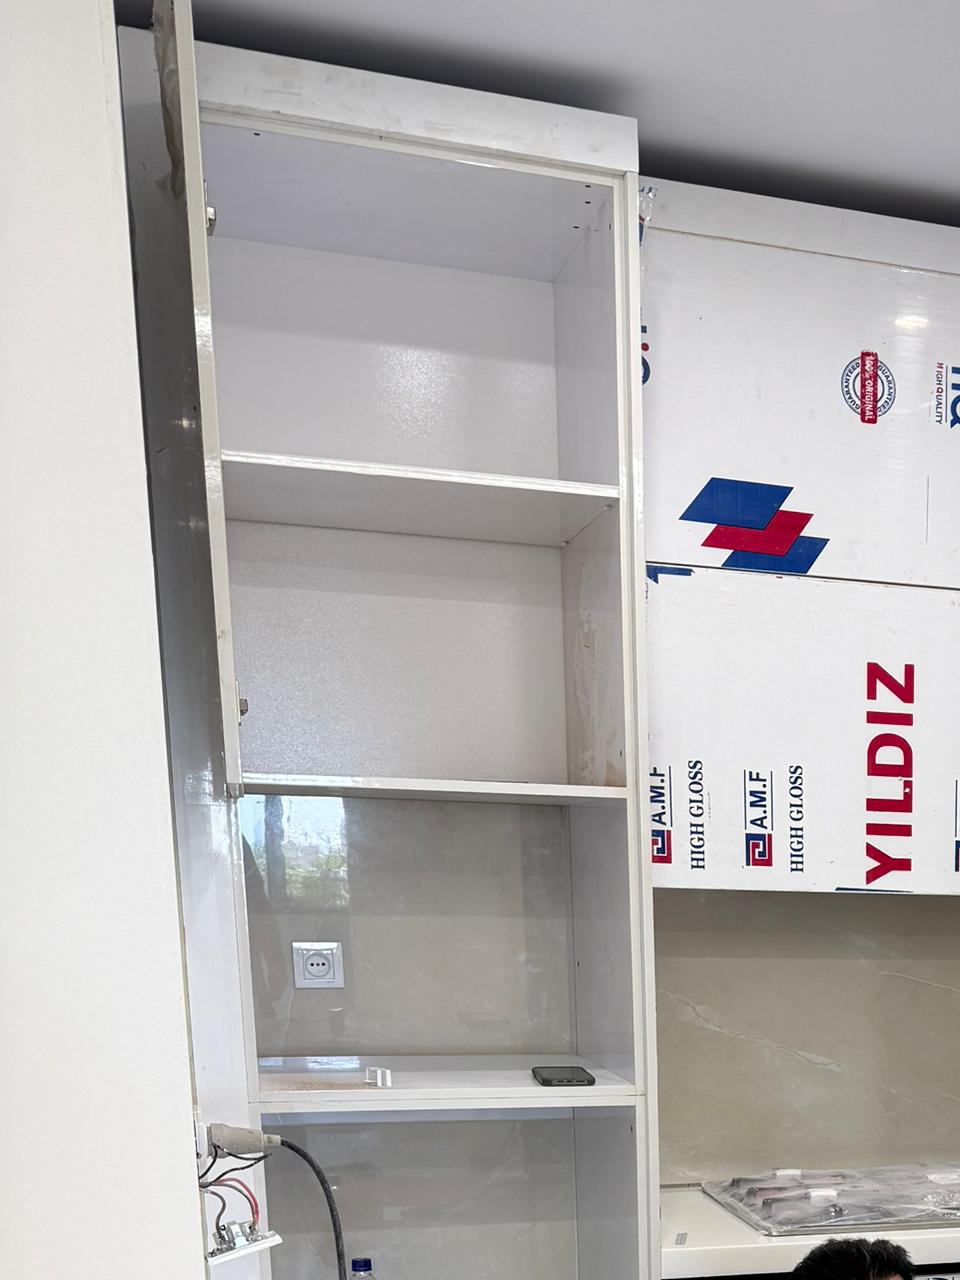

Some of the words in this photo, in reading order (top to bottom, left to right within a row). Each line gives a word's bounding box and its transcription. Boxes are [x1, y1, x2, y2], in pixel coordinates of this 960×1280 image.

[936, 362, 944, 386] HIGH
[863, 380, 875, 421] ORIGINAL
[935, 387, 944, 425] QUALITY
[688, 760, 704, 818] GLOSS
[788, 765, 804, 821] GLOSS
[866, 662, 915, 885] YILDIZ
[749, 771, 768, 830] A.M.F
[690, 822, 705, 870] HIGH
[789, 827, 804, 873] HIGH
